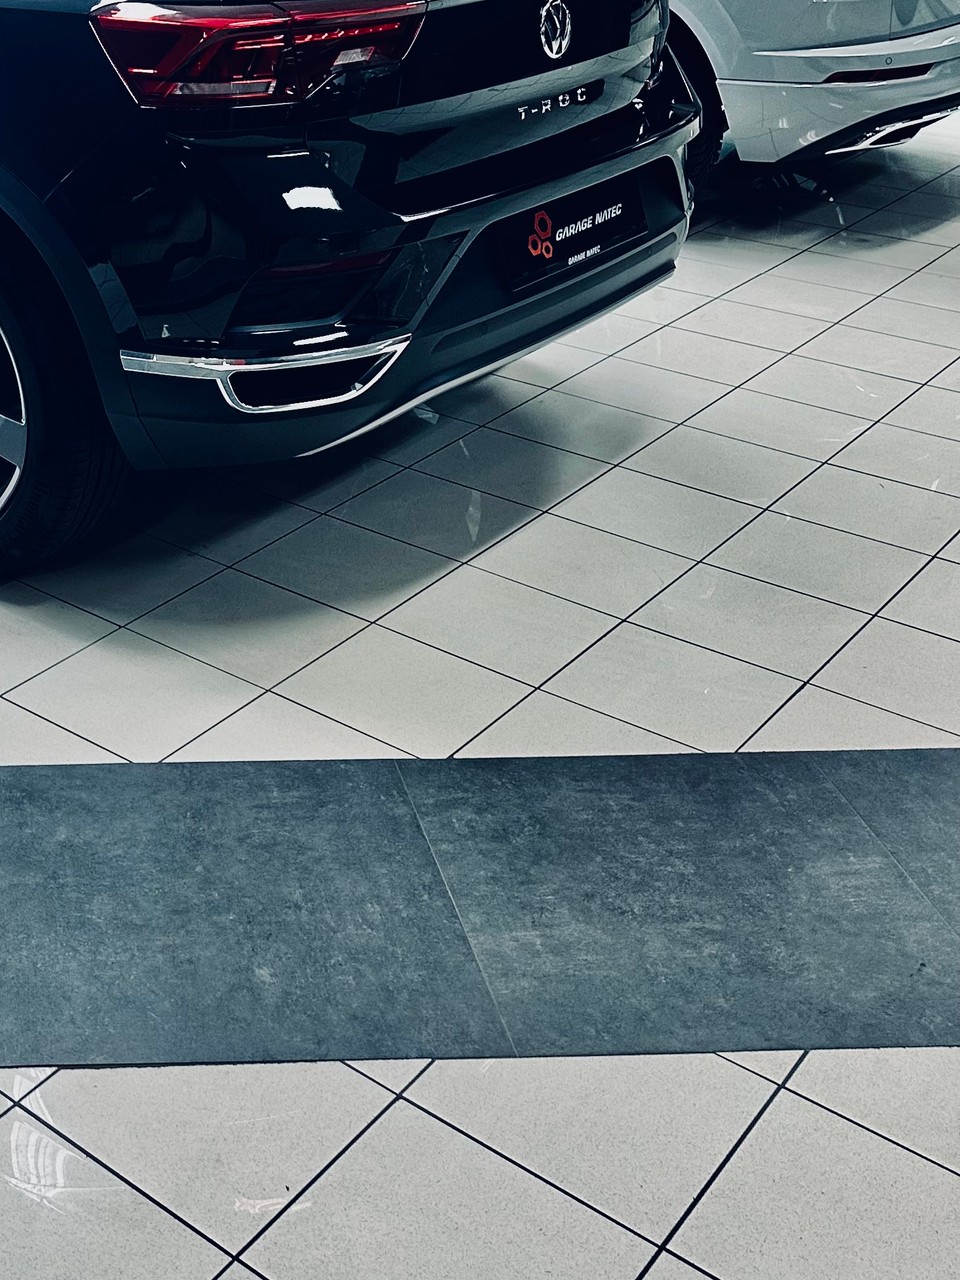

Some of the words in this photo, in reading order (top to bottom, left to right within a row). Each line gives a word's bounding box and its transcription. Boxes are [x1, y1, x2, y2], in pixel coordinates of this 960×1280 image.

[517, 87, 587, 121] T-ROC
[555, 215, 593, 242] GARAGE
[594, 203, 623, 225] NATEC
